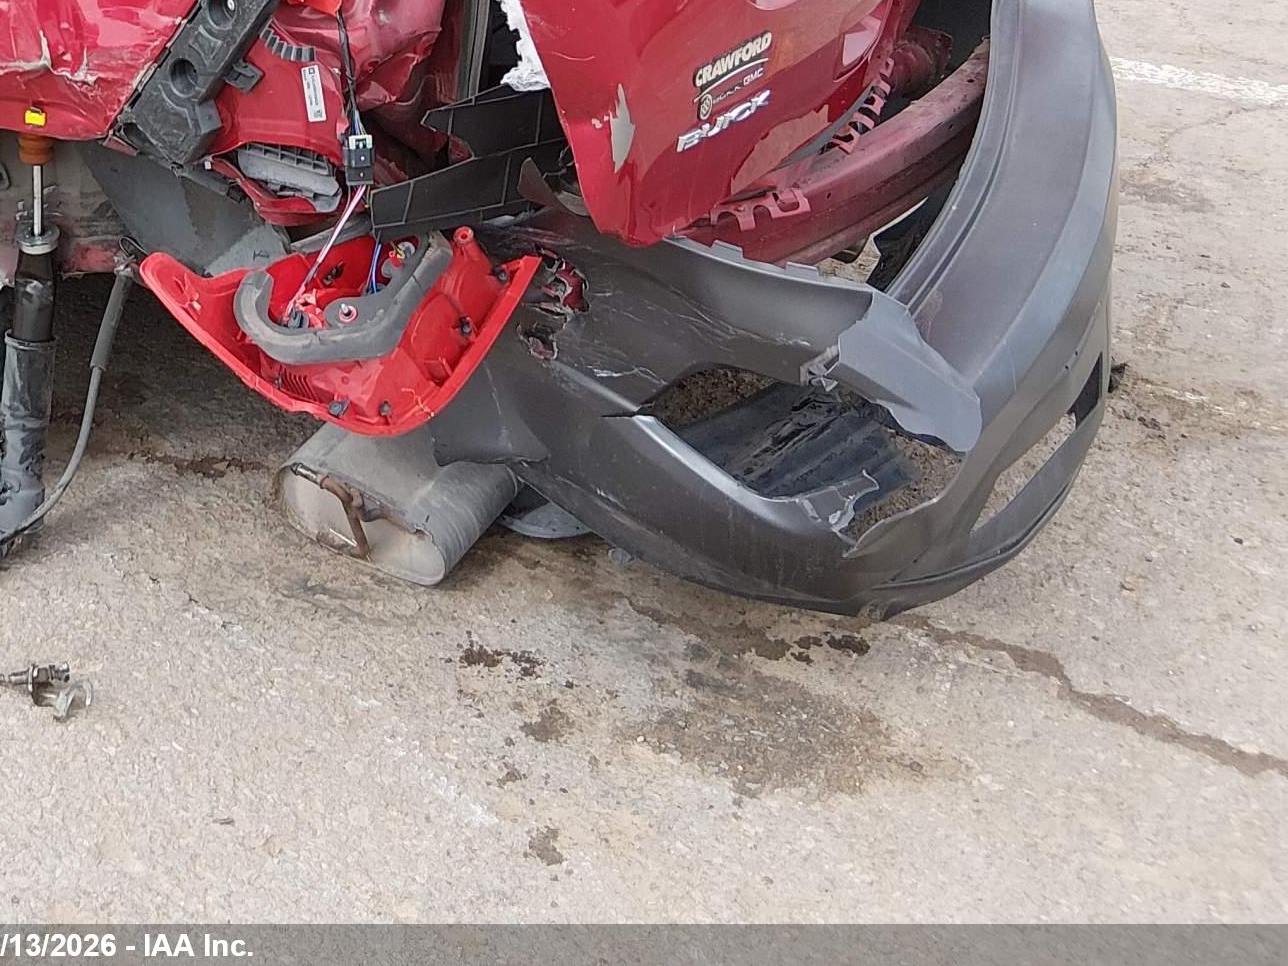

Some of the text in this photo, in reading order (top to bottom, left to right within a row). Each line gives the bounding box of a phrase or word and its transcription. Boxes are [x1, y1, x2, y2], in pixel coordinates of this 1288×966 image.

[695, 31, 772, 87] CRAWFORD
[743, 67, 764, 86] GMC
[676, 89, 770, 152] BUICK
